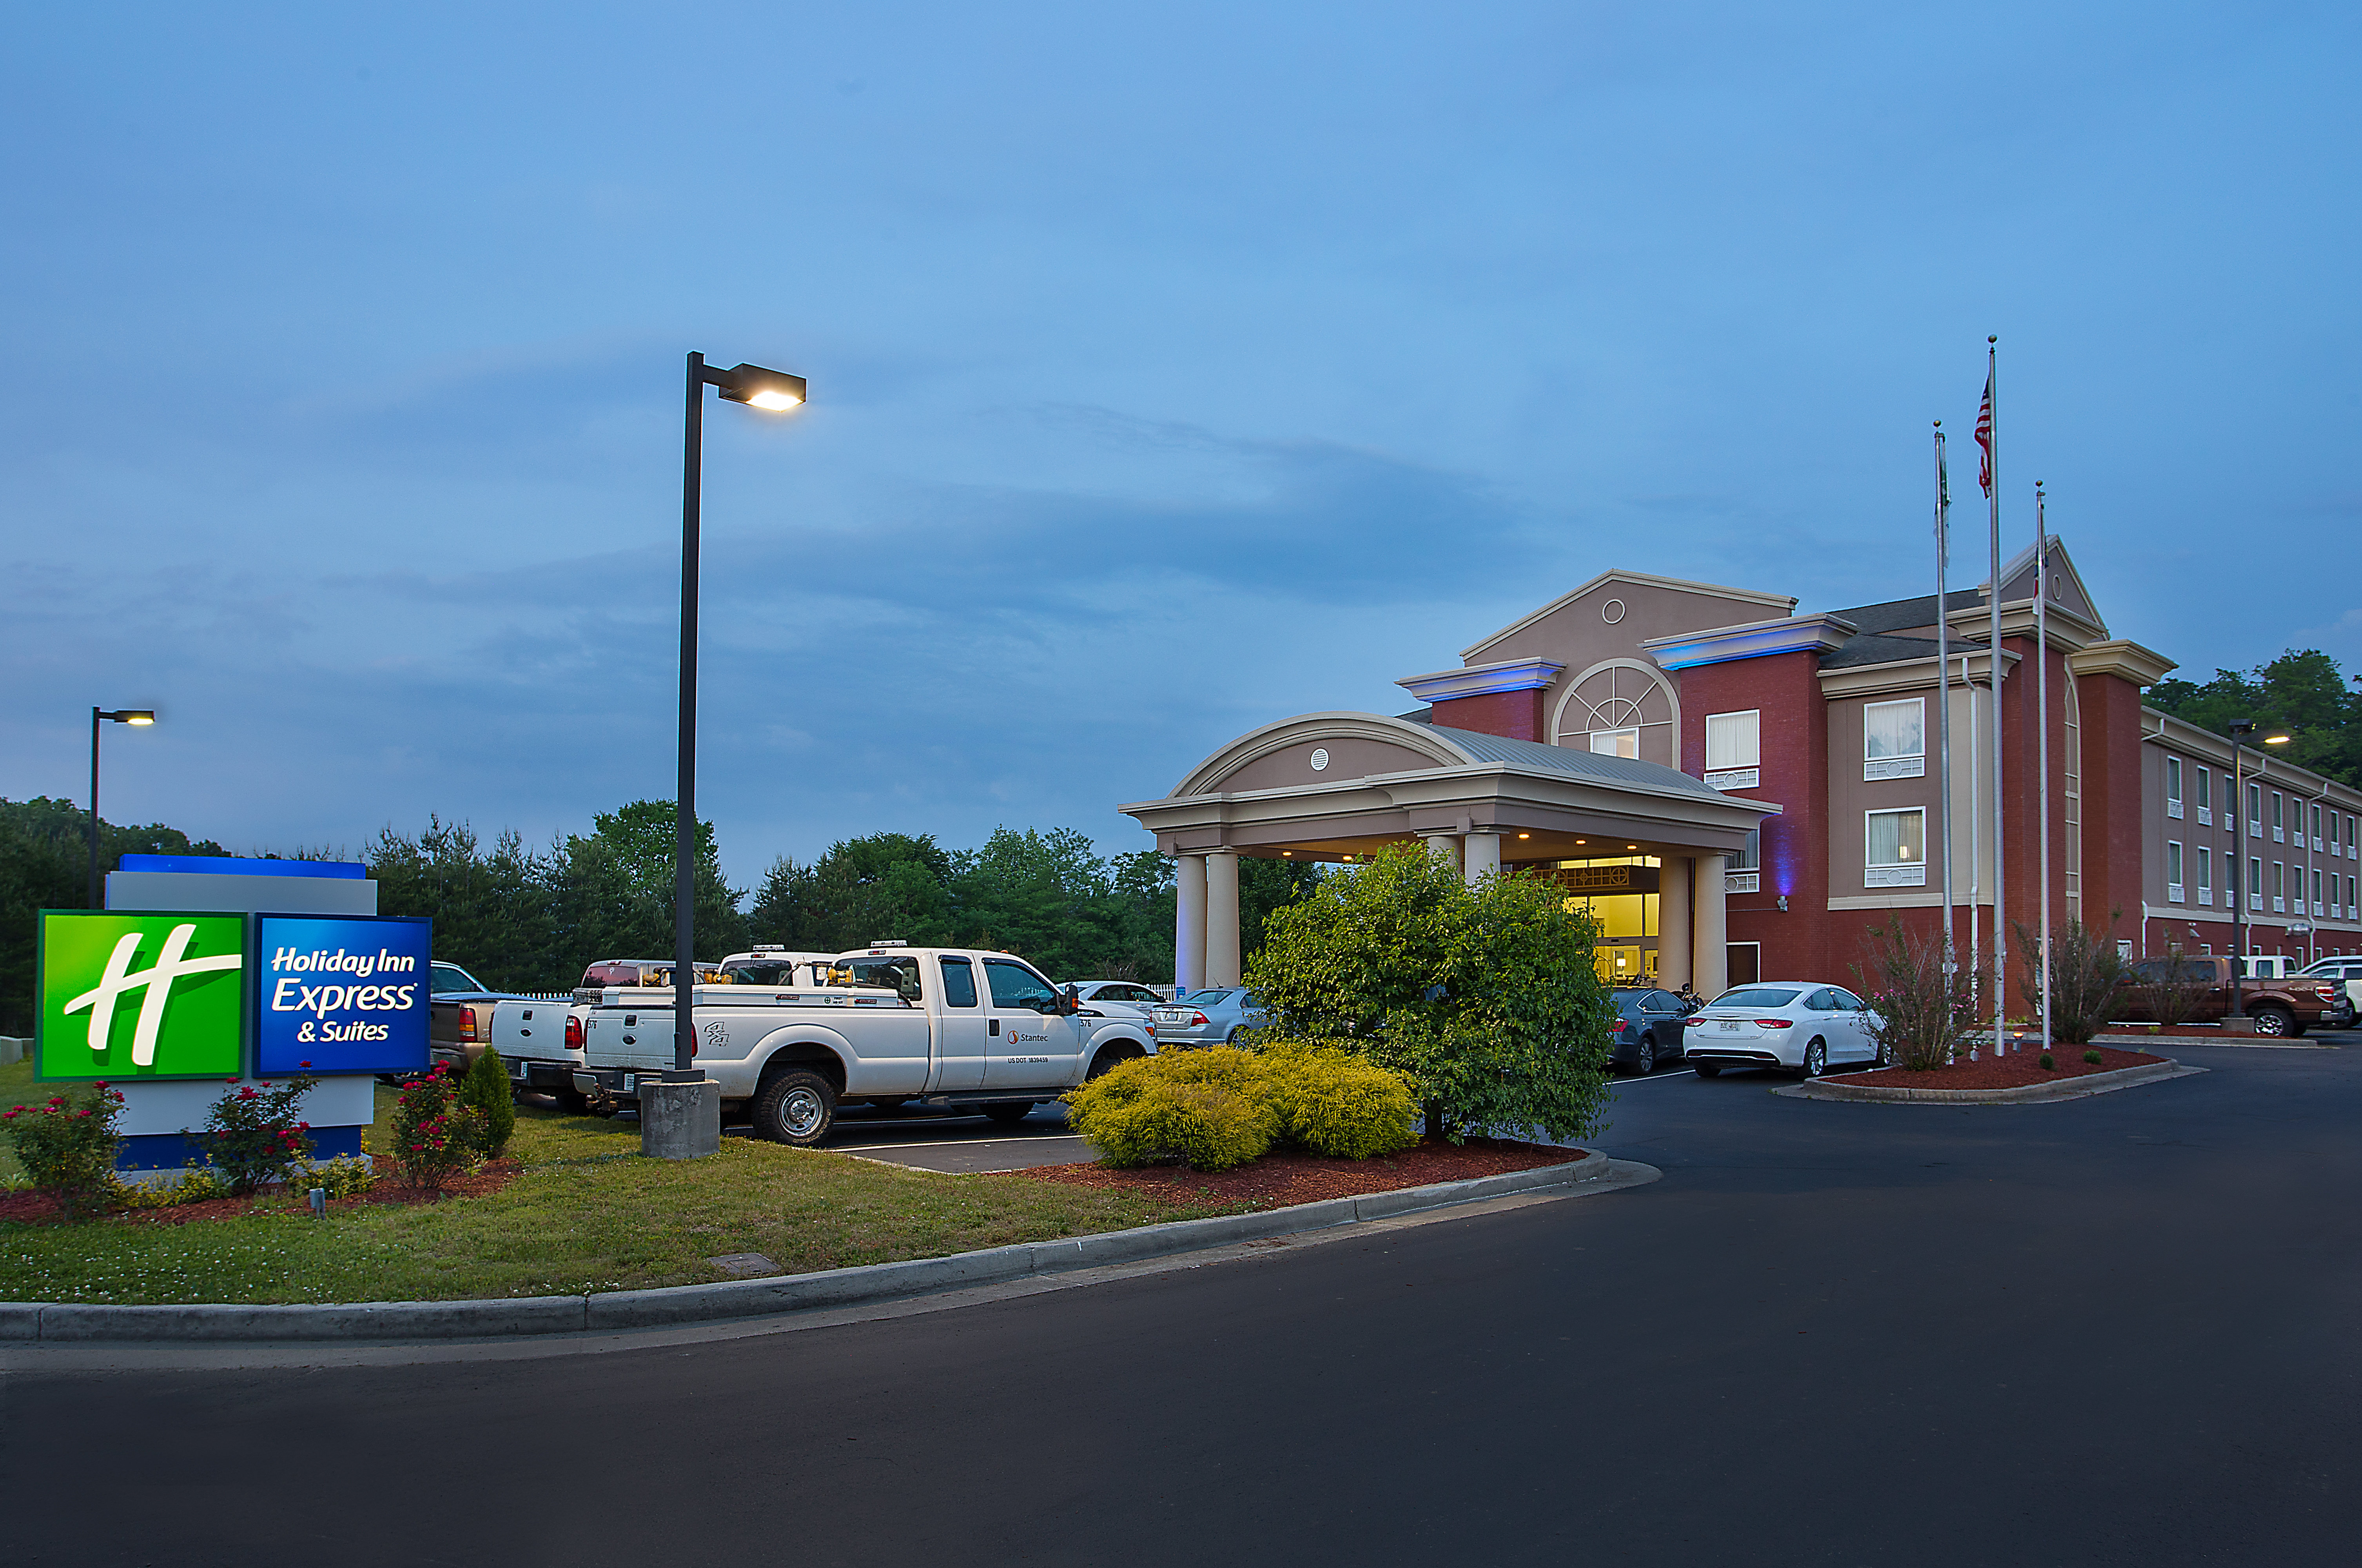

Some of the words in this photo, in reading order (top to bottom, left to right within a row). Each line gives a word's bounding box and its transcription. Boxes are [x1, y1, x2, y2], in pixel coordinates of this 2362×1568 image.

[271, 947, 375, 977] Holiday
[377, 948, 415, 972] Inn
[271, 978, 415, 1020] Express
[297, 1021, 316, 1042] &
[319, 1021, 389, 1042] Suites
[588, 1020, 597, 1029] 376
